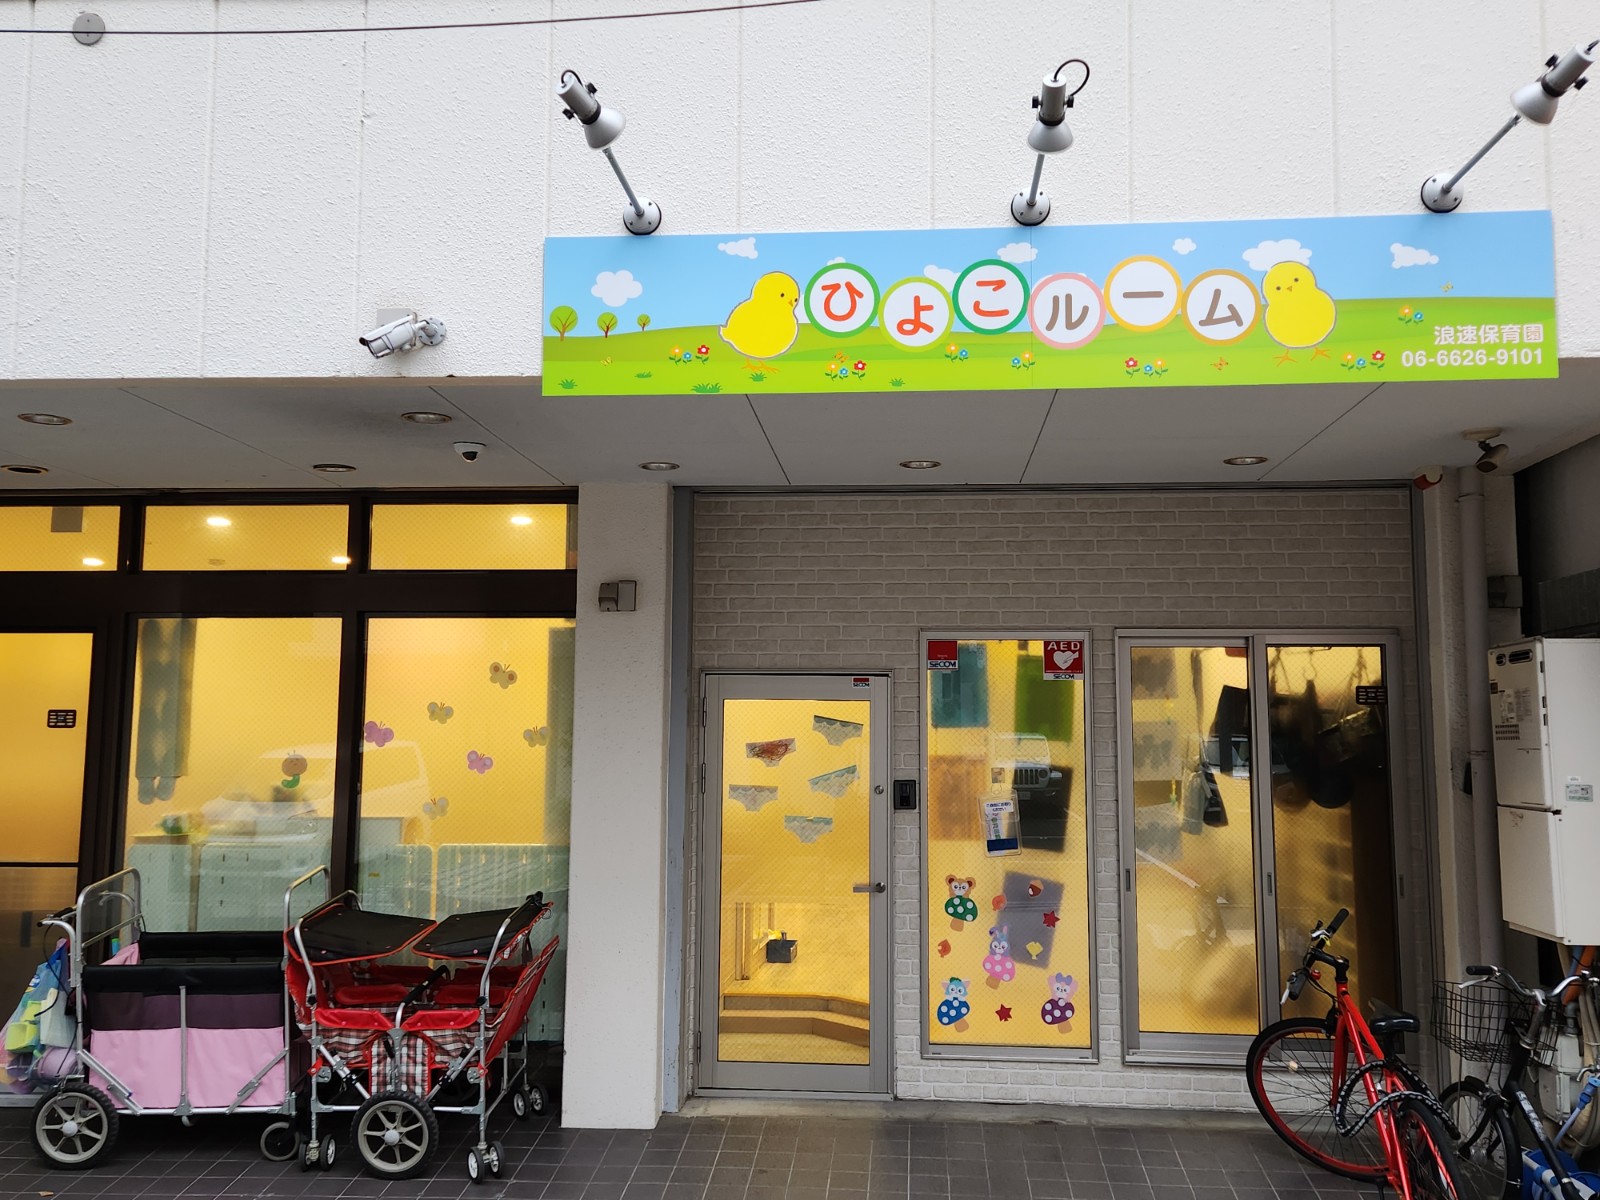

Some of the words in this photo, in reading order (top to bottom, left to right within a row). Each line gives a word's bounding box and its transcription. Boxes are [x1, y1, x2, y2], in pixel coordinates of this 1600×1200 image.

[820, 278, 1244, 337] ひよこルーム
[1434, 324, 1544, 345] 浪速保育園
[1401, 348, 1543, 367] 06-6626-9101
[1047, 641, 1080, 650] AED
